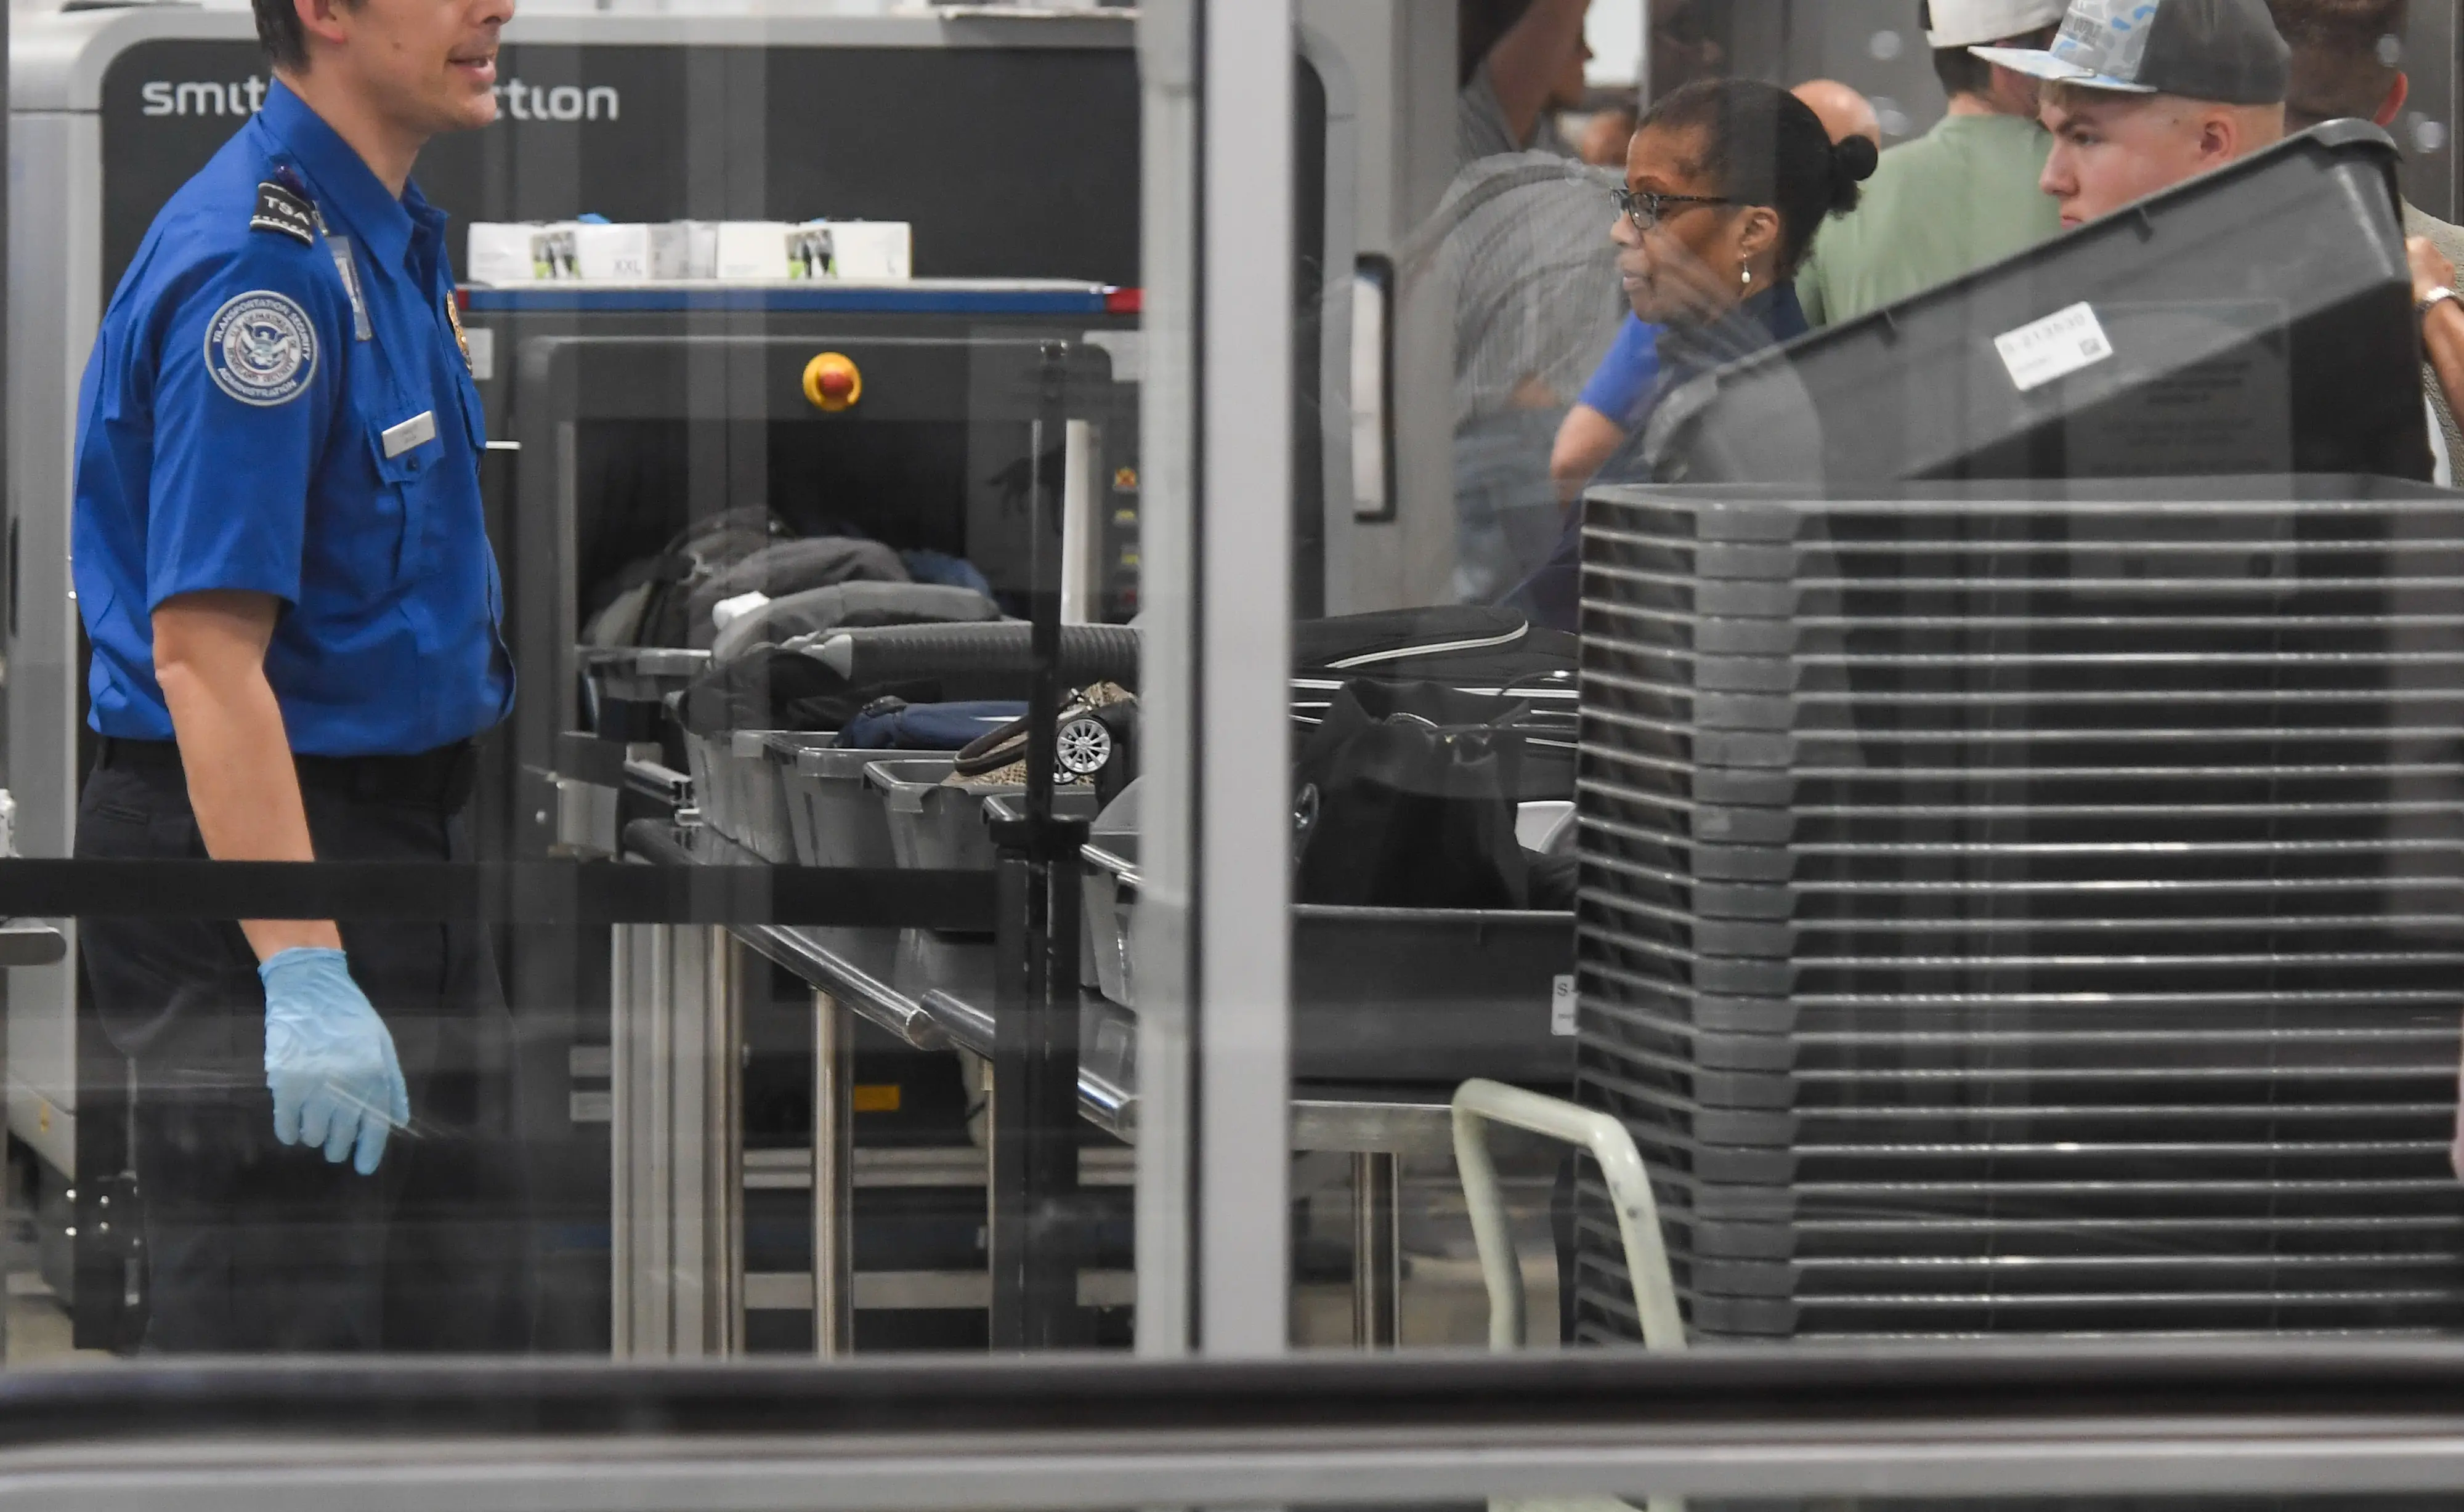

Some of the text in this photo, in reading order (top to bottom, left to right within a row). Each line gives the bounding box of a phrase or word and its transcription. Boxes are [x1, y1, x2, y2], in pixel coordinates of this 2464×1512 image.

[264, 195, 310, 225] TSA
[614, 259, 642, 275] XXL
[213, 299, 311, 360] TRANSPORTATION SECURITY
[217, 368, 297, 397] ADMINISTRATION
